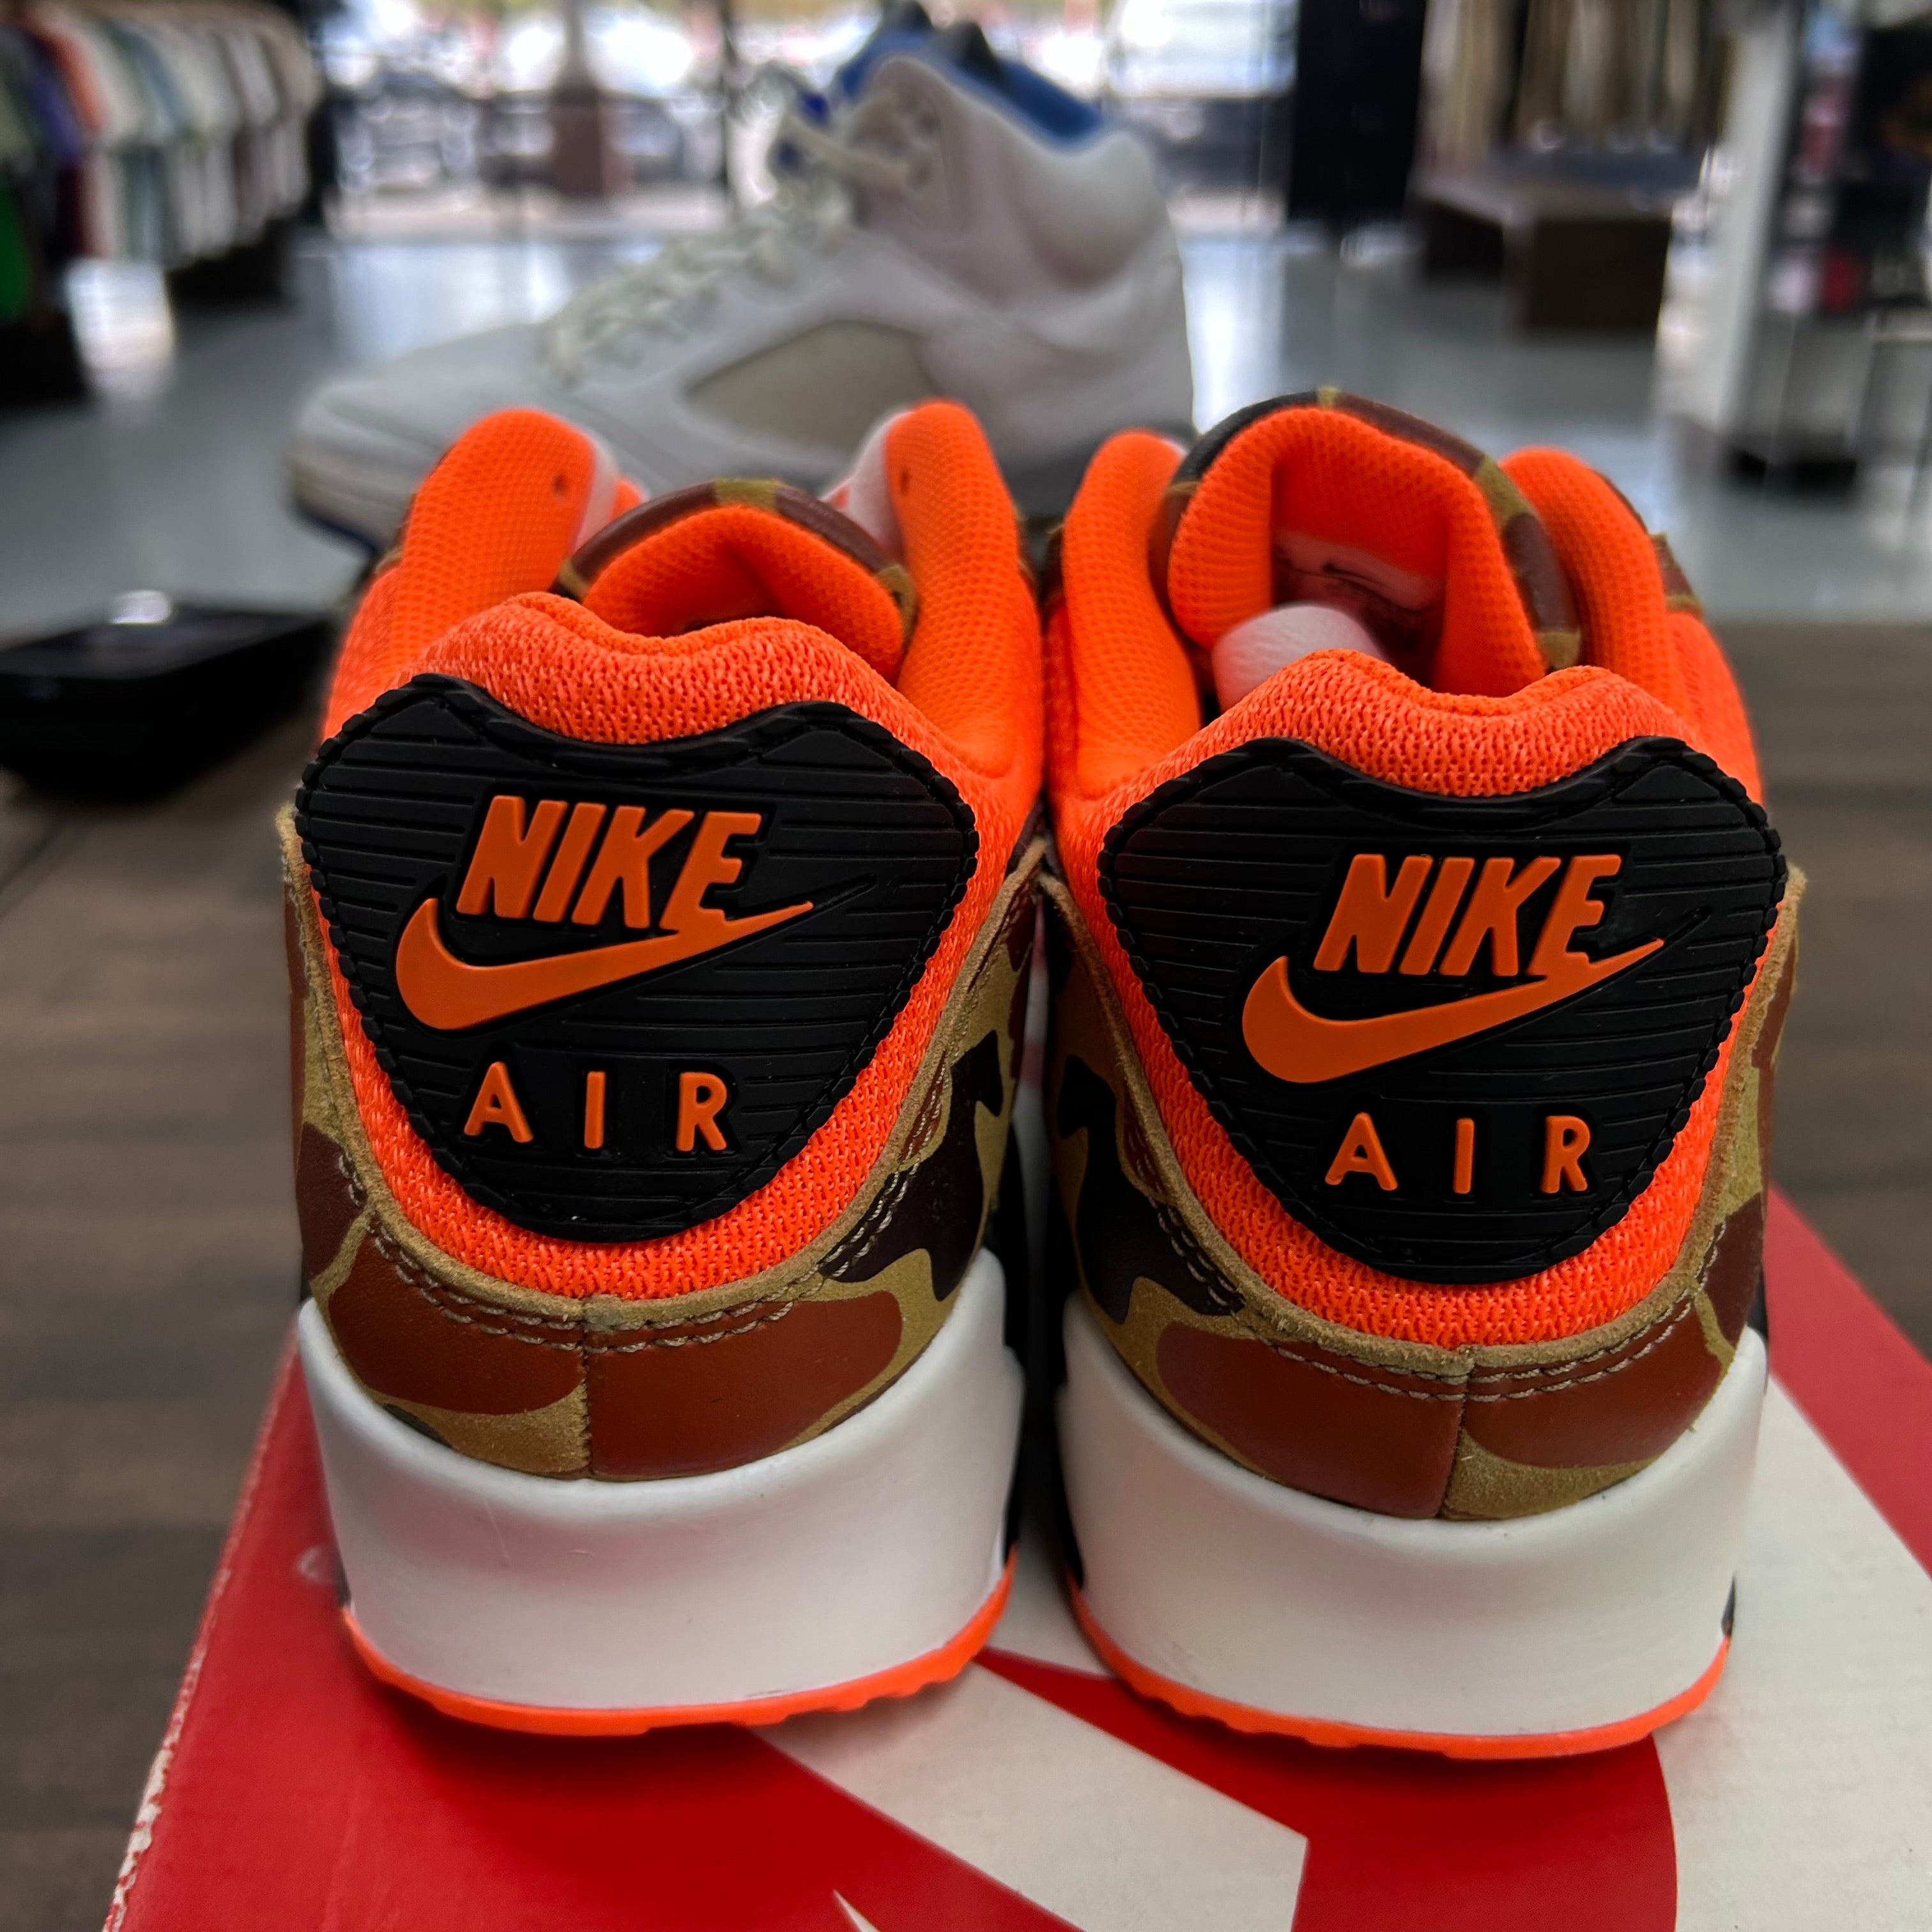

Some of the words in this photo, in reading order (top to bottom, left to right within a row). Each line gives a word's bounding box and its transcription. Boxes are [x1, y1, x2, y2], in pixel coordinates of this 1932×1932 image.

[456, 795, 762, 934] NIKE
[1314, 854, 1621, 977] NIKE
[464, 1061, 728, 1152] AIR
[1324, 1112, 1591, 1194] AIR
